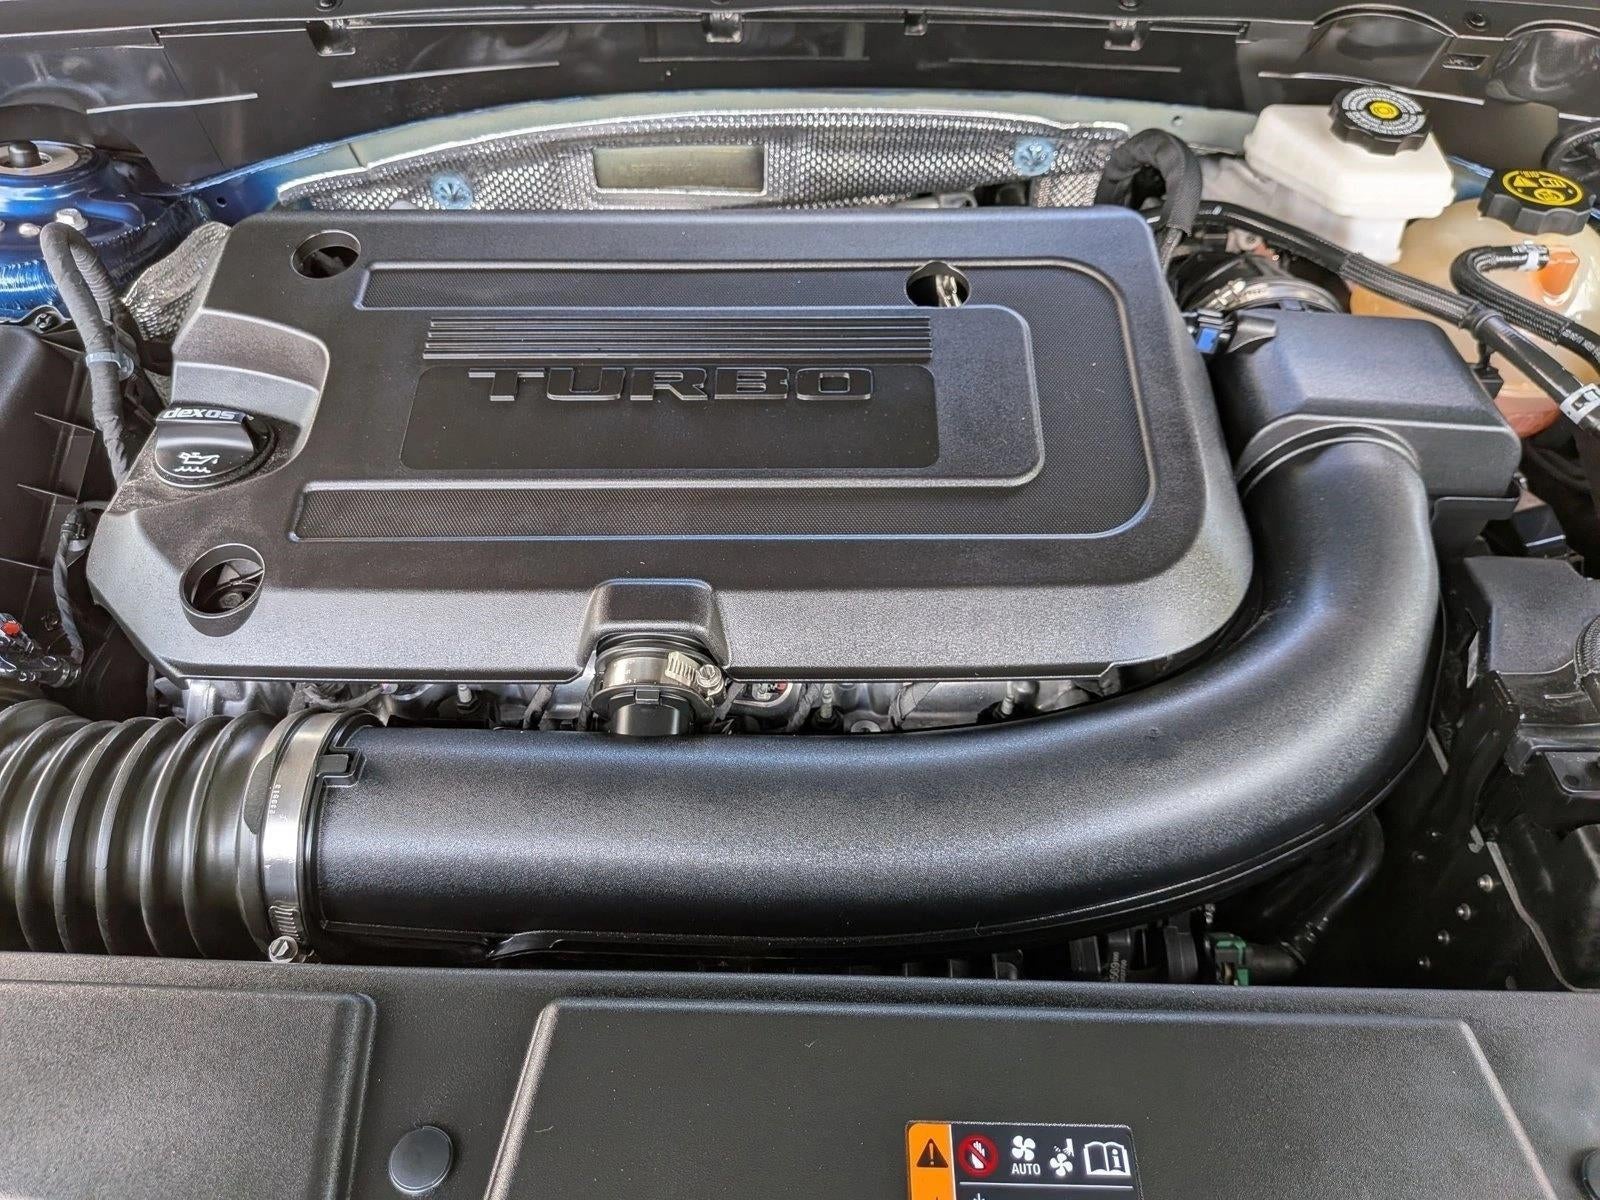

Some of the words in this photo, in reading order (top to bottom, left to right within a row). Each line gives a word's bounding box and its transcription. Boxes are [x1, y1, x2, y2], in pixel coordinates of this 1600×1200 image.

[468, 367, 873, 402] TURBO
[162, 407, 236, 420] dexos
[1011, 1162, 1041, 1175] AUTO
